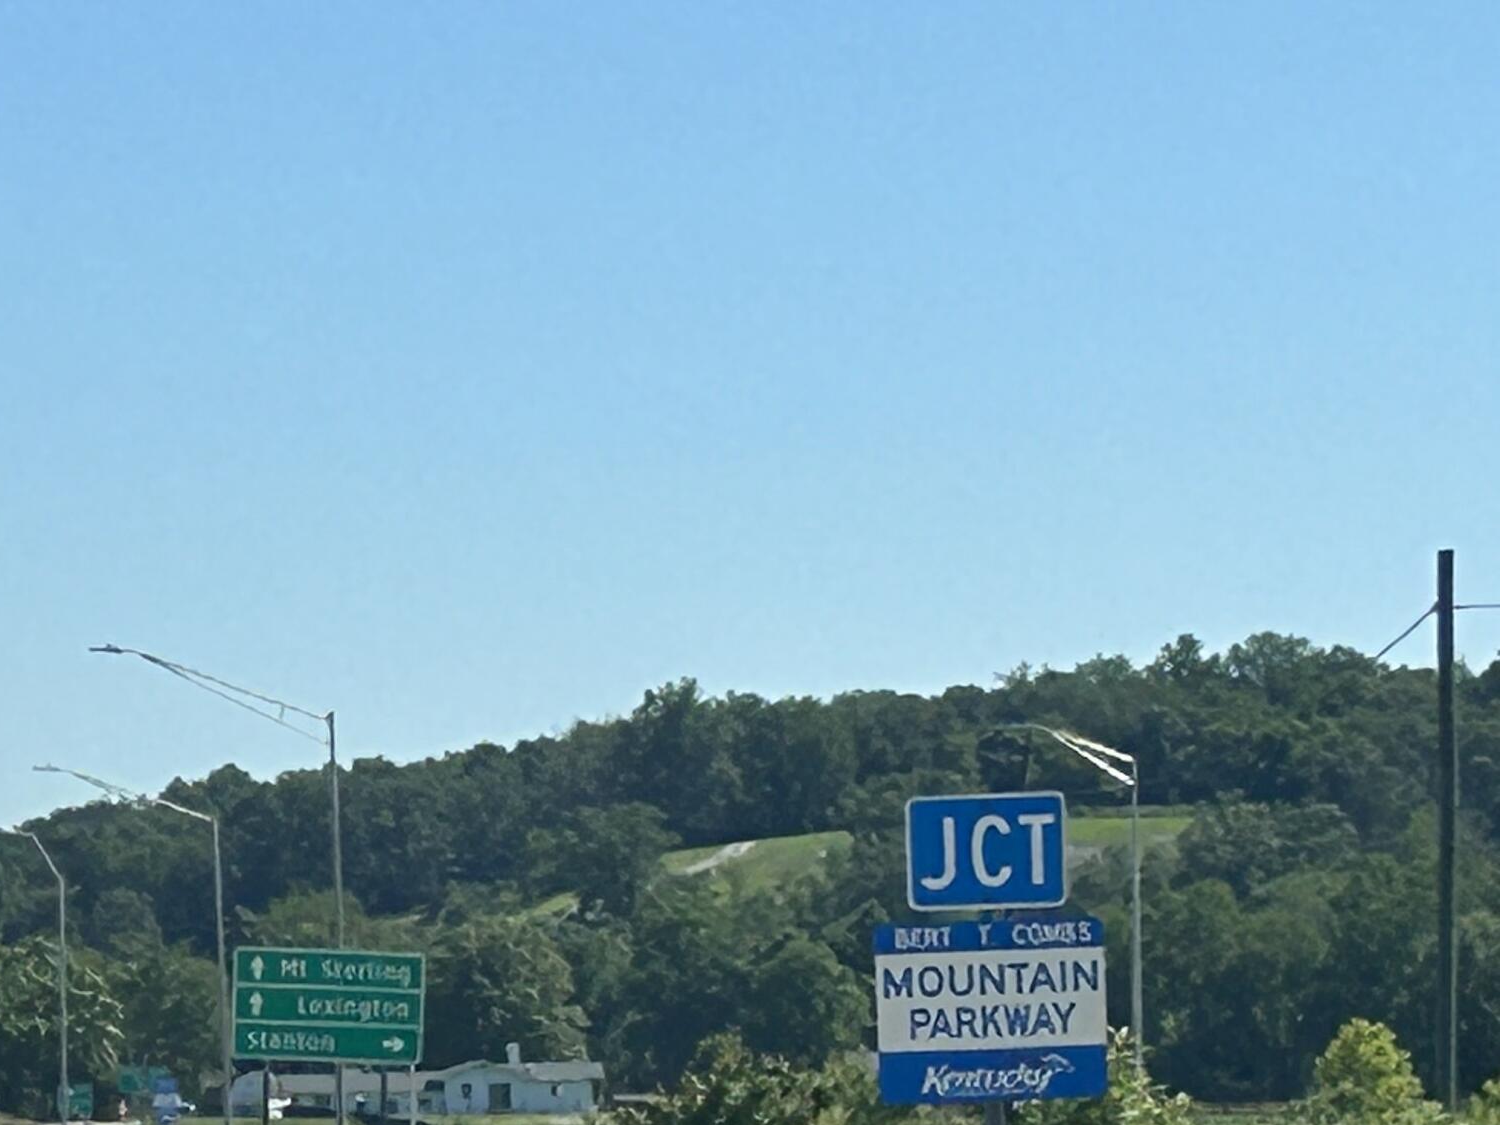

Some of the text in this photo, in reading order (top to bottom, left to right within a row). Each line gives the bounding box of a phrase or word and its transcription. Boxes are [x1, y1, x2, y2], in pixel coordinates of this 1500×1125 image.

[921, 813, 1055, 890] JCT
[883, 959, 1099, 1000] MOUNTAIN
[297, 995, 409, 1022] Lexington
[910, 1002, 1076, 1040] PARKWAY
